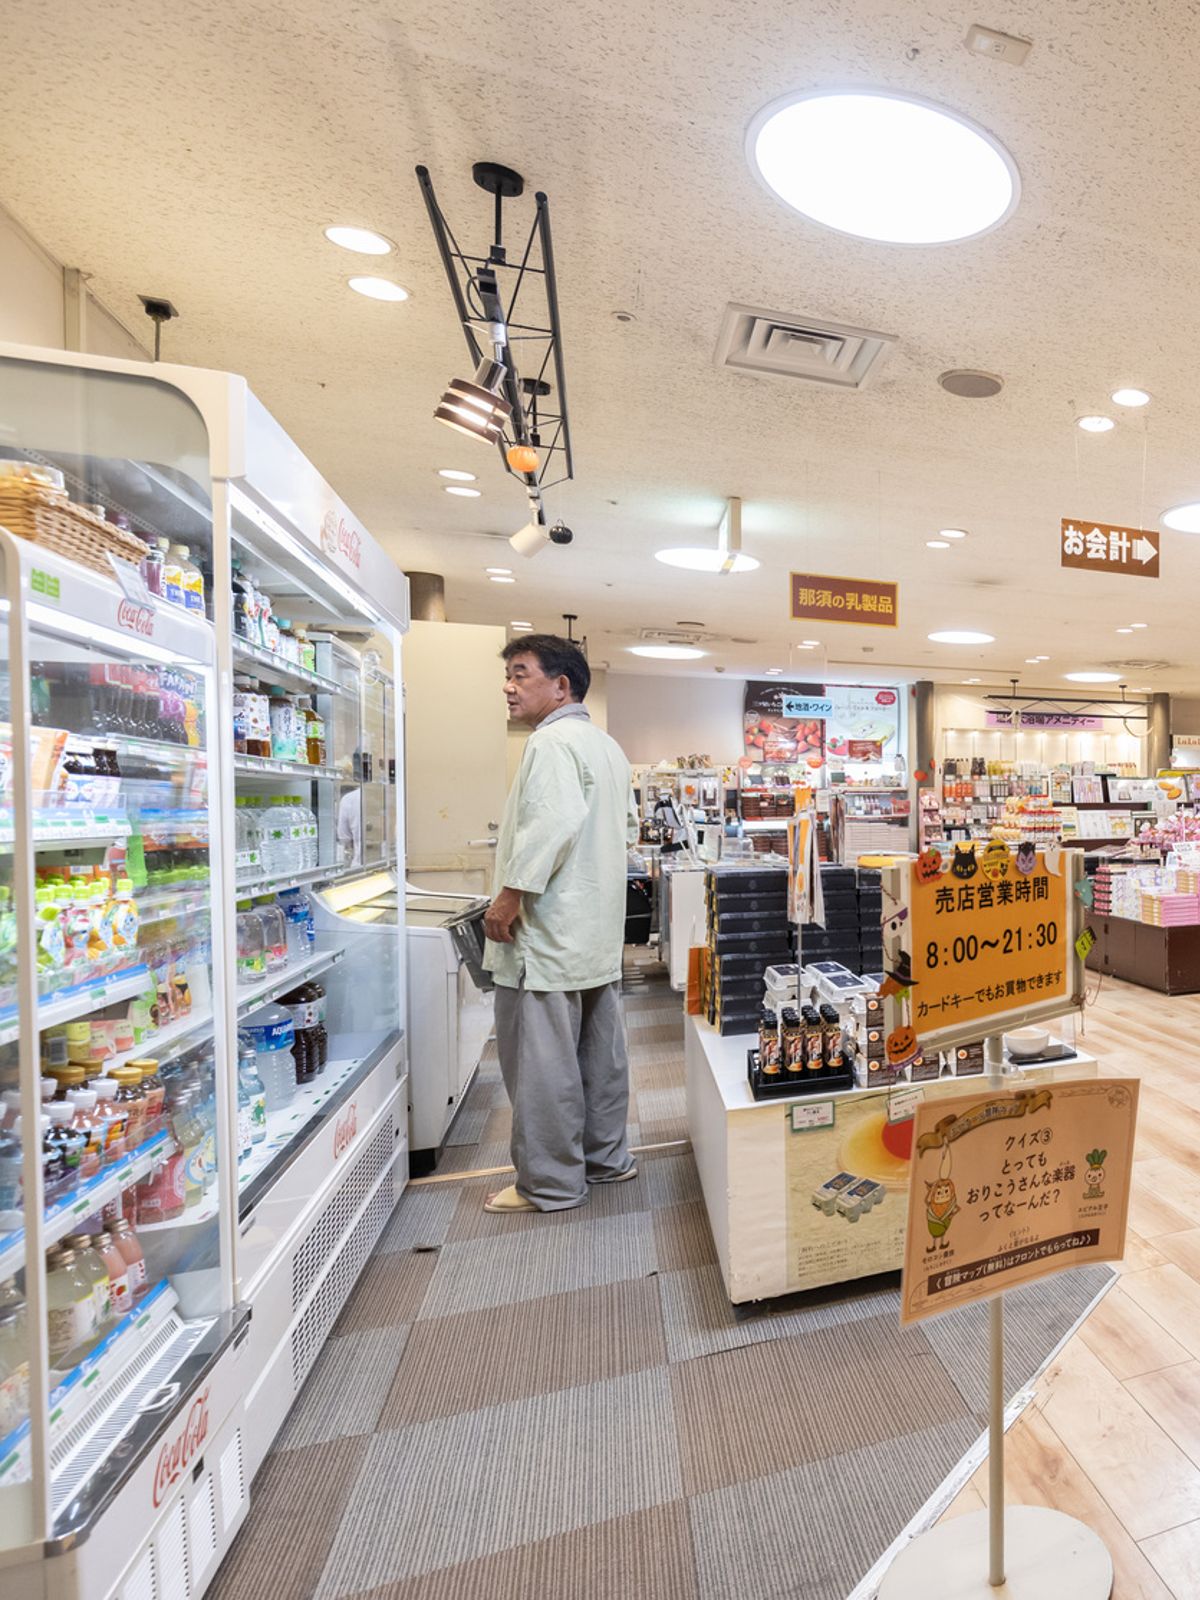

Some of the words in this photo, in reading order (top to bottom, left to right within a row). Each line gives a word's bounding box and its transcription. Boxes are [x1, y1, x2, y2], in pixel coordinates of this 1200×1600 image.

[1064, 525, 1131, 563] お会計
[799, 588, 893, 614] 那須の乳製品
[795, 702, 832, 712] 地酒・ワイン
[935, 876, 1049, 915] 売店営業時間
[917, 969, 1063, 1018] カードキーでもお買物できます
[1005, 1128, 1053, 1151] クイズ③
[1001, 1152, 1047, 1175] とっても
[967, 1165, 1075, 1204] おりこうさんな楽器
[153, 1384, 212, 1508] Coca-Cola
